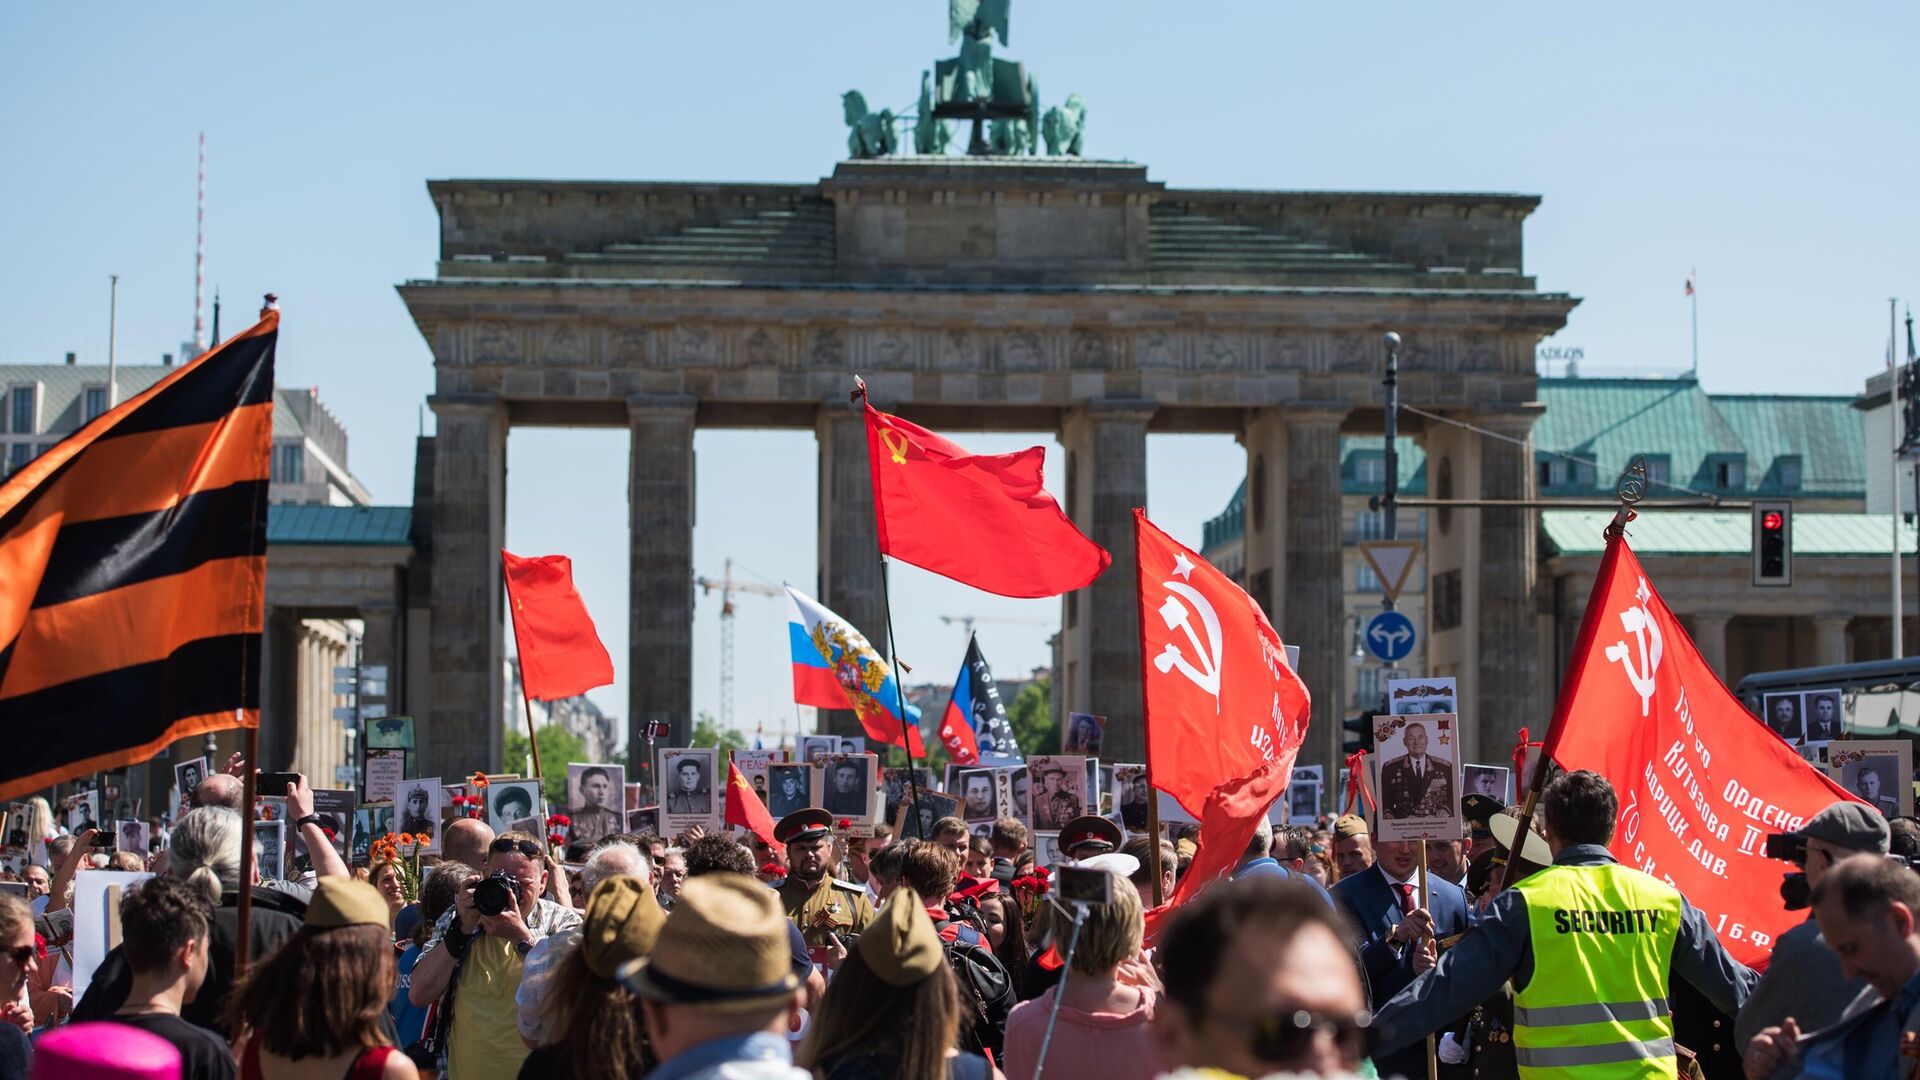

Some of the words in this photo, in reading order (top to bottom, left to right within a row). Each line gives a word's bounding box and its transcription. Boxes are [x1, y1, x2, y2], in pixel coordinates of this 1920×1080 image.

[1540, 347, 1583, 359] ADLON
[1621, 789, 1640, 844] 79
[1723, 778, 1804, 833] ОРДЕНА
[1554, 909, 1659, 935] SECURITY
